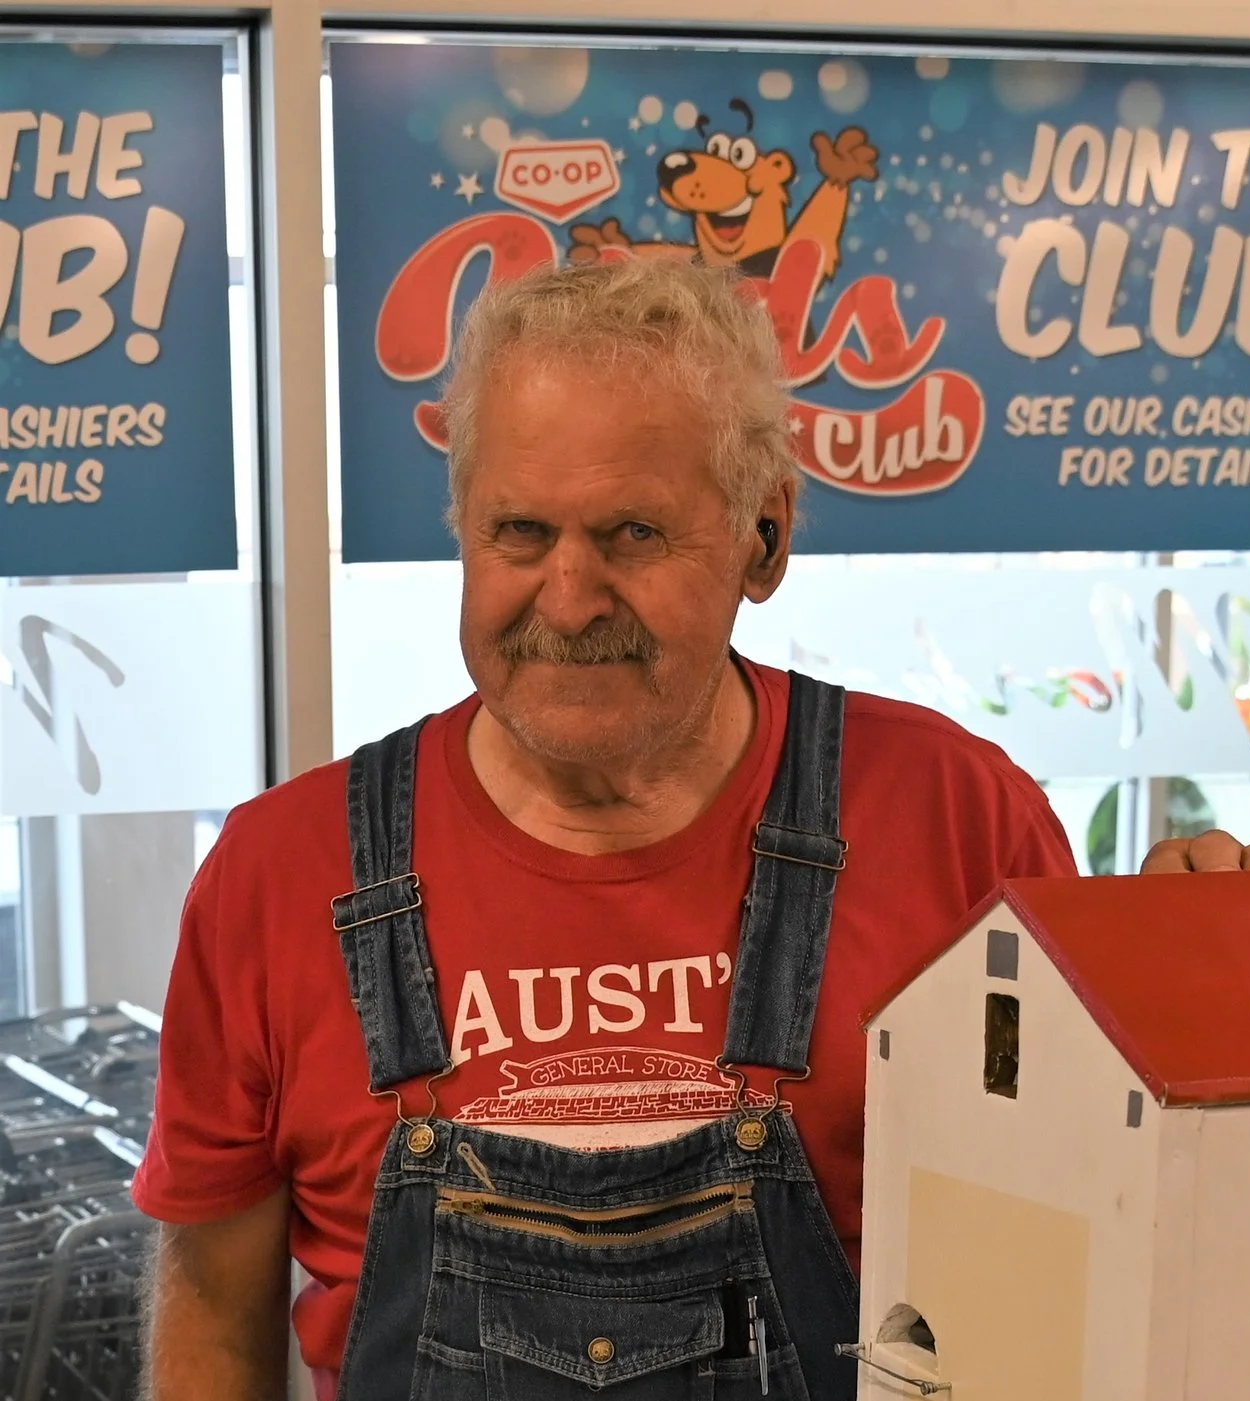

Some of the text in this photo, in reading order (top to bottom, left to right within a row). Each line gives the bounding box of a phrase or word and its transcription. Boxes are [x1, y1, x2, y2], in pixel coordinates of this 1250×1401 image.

[1002, 122, 1190, 208] JOIN
[813, 376, 964, 484] Club
[1004, 395, 1076, 437] SEE
[1083, 396, 1159, 437] OUR
[1057, 446, 1136, 488] FOR
[530, 1054, 713, 1086] GENERAL STORE
